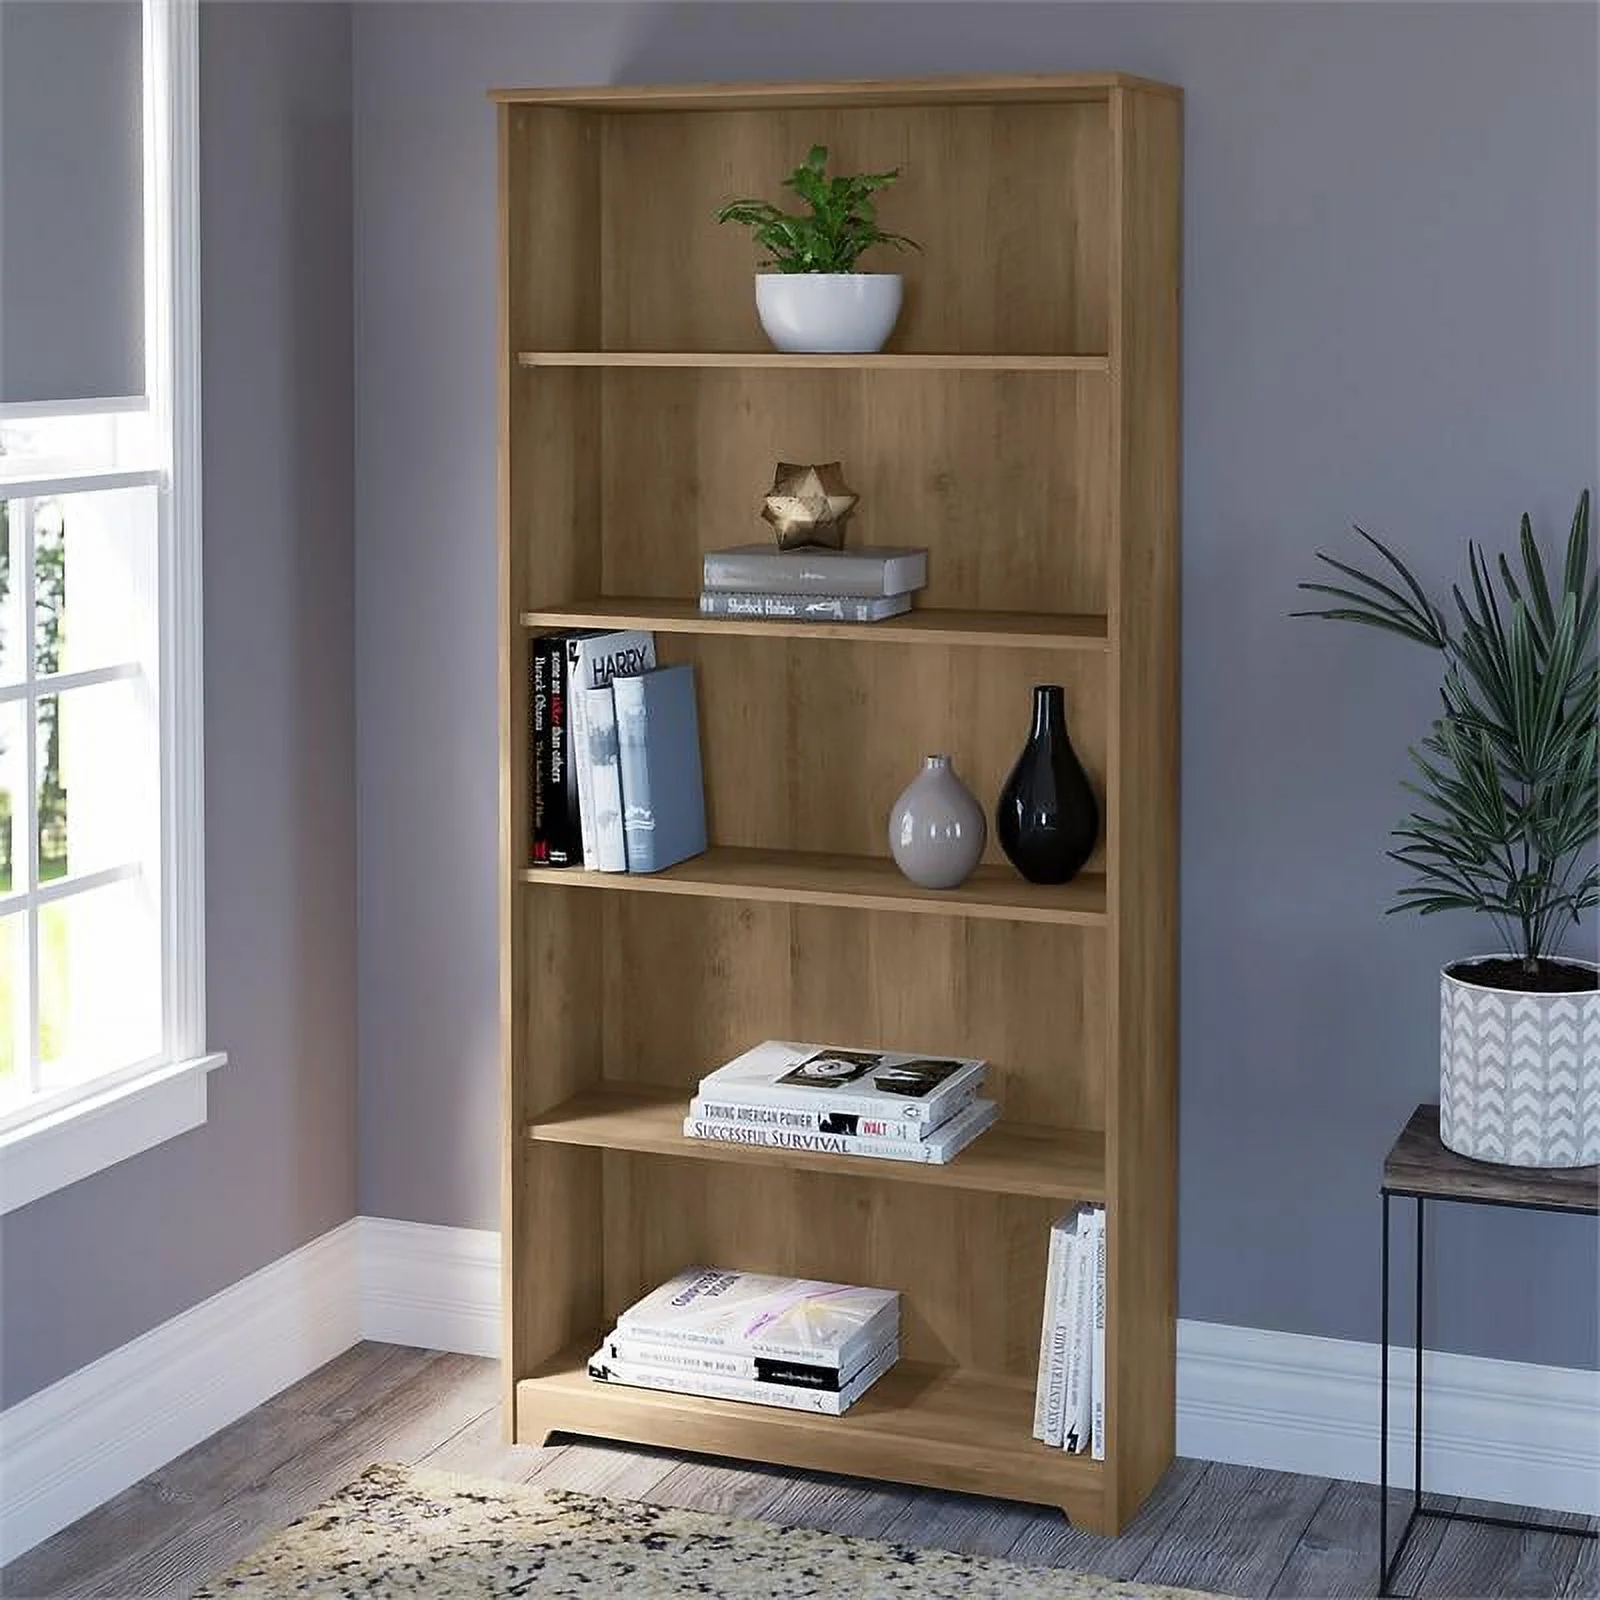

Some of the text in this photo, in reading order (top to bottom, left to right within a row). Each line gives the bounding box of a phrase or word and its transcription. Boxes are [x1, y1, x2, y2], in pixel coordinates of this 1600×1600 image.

[552, 651, 561, 678] some
[592, 647, 647, 684] HARRY
[535, 656, 547, 731] Barack Obama
[737, 1107, 778, 1124] AMERICAN
[780, 1111, 813, 1128] POWER
[863, 1121, 888, 1136] WALT
[694, 1122, 768, 1146] SUCCESSFUL
[771, 1130, 851, 1154] SURVIVAL
